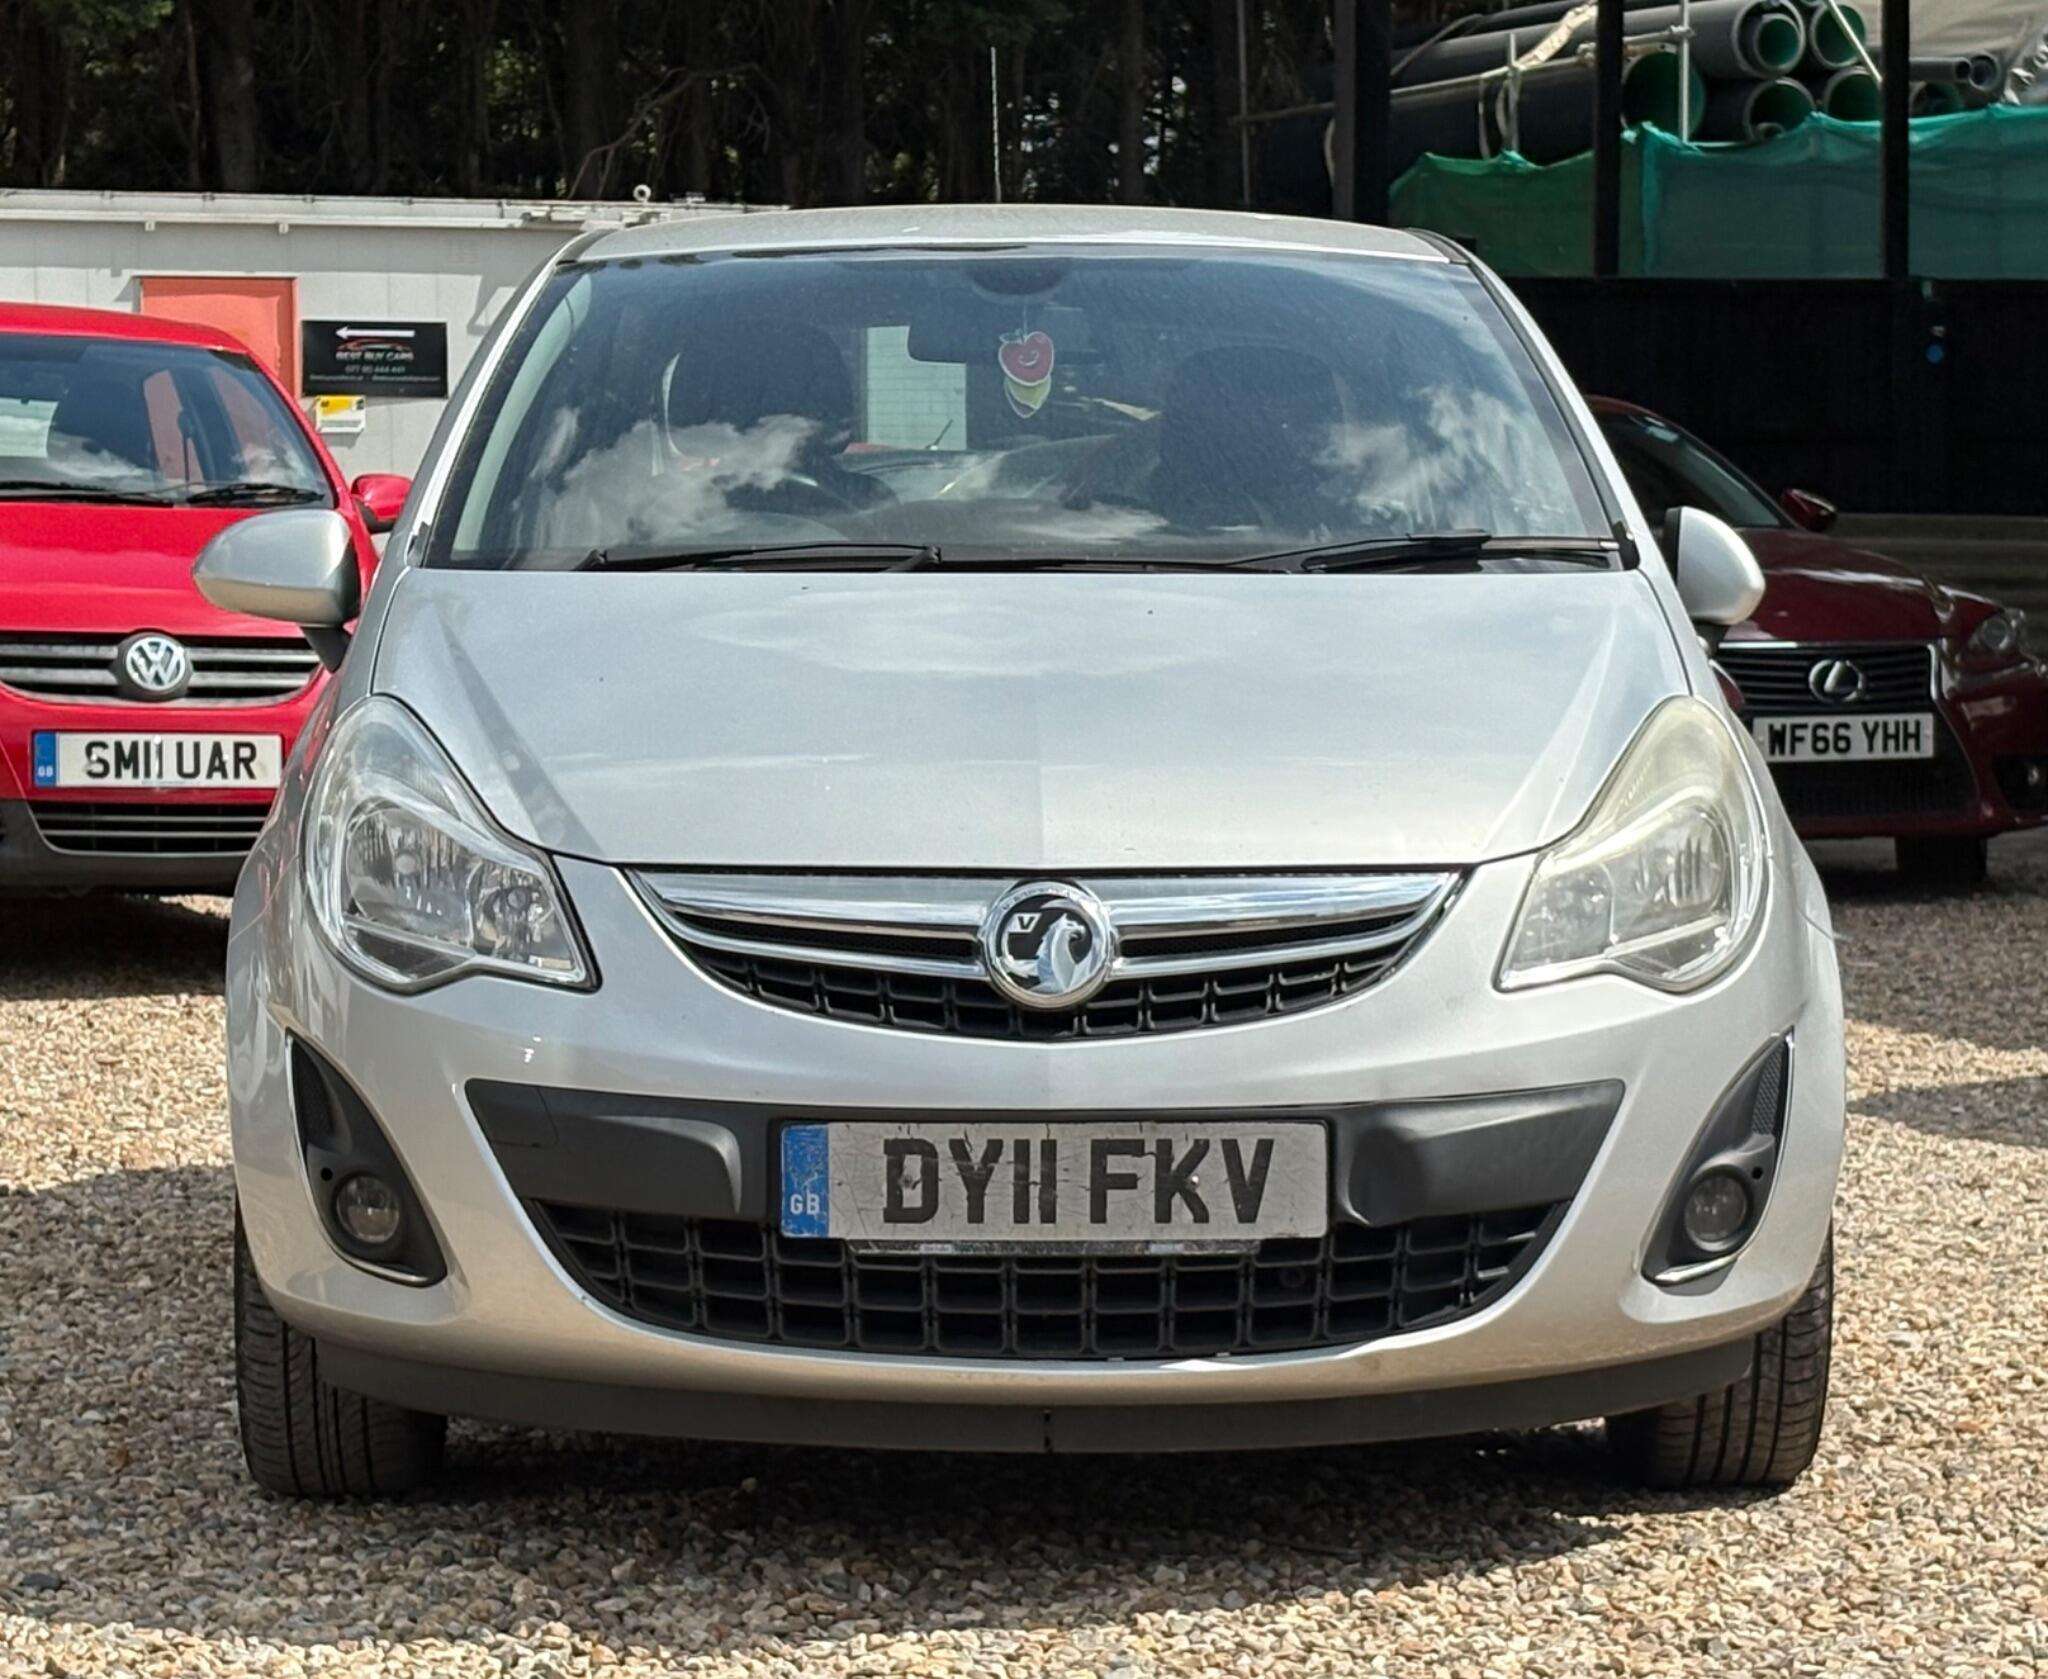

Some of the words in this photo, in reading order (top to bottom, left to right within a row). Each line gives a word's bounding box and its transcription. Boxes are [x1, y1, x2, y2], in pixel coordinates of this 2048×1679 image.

[335, 351, 363, 361] BEST
[364, 351, 384, 361] BUY
[386, 351, 415, 361] CARS
[126, 637, 185, 690] VW
[1768, 722, 1851, 756] WF66
[1862, 719, 1922, 753] YHH
[176, 741, 258, 780] UAR
[882, 1138, 1058, 1225] DY11
[1090, 1138, 1275, 1225] FKV
[789, 1193, 821, 1216] GB
